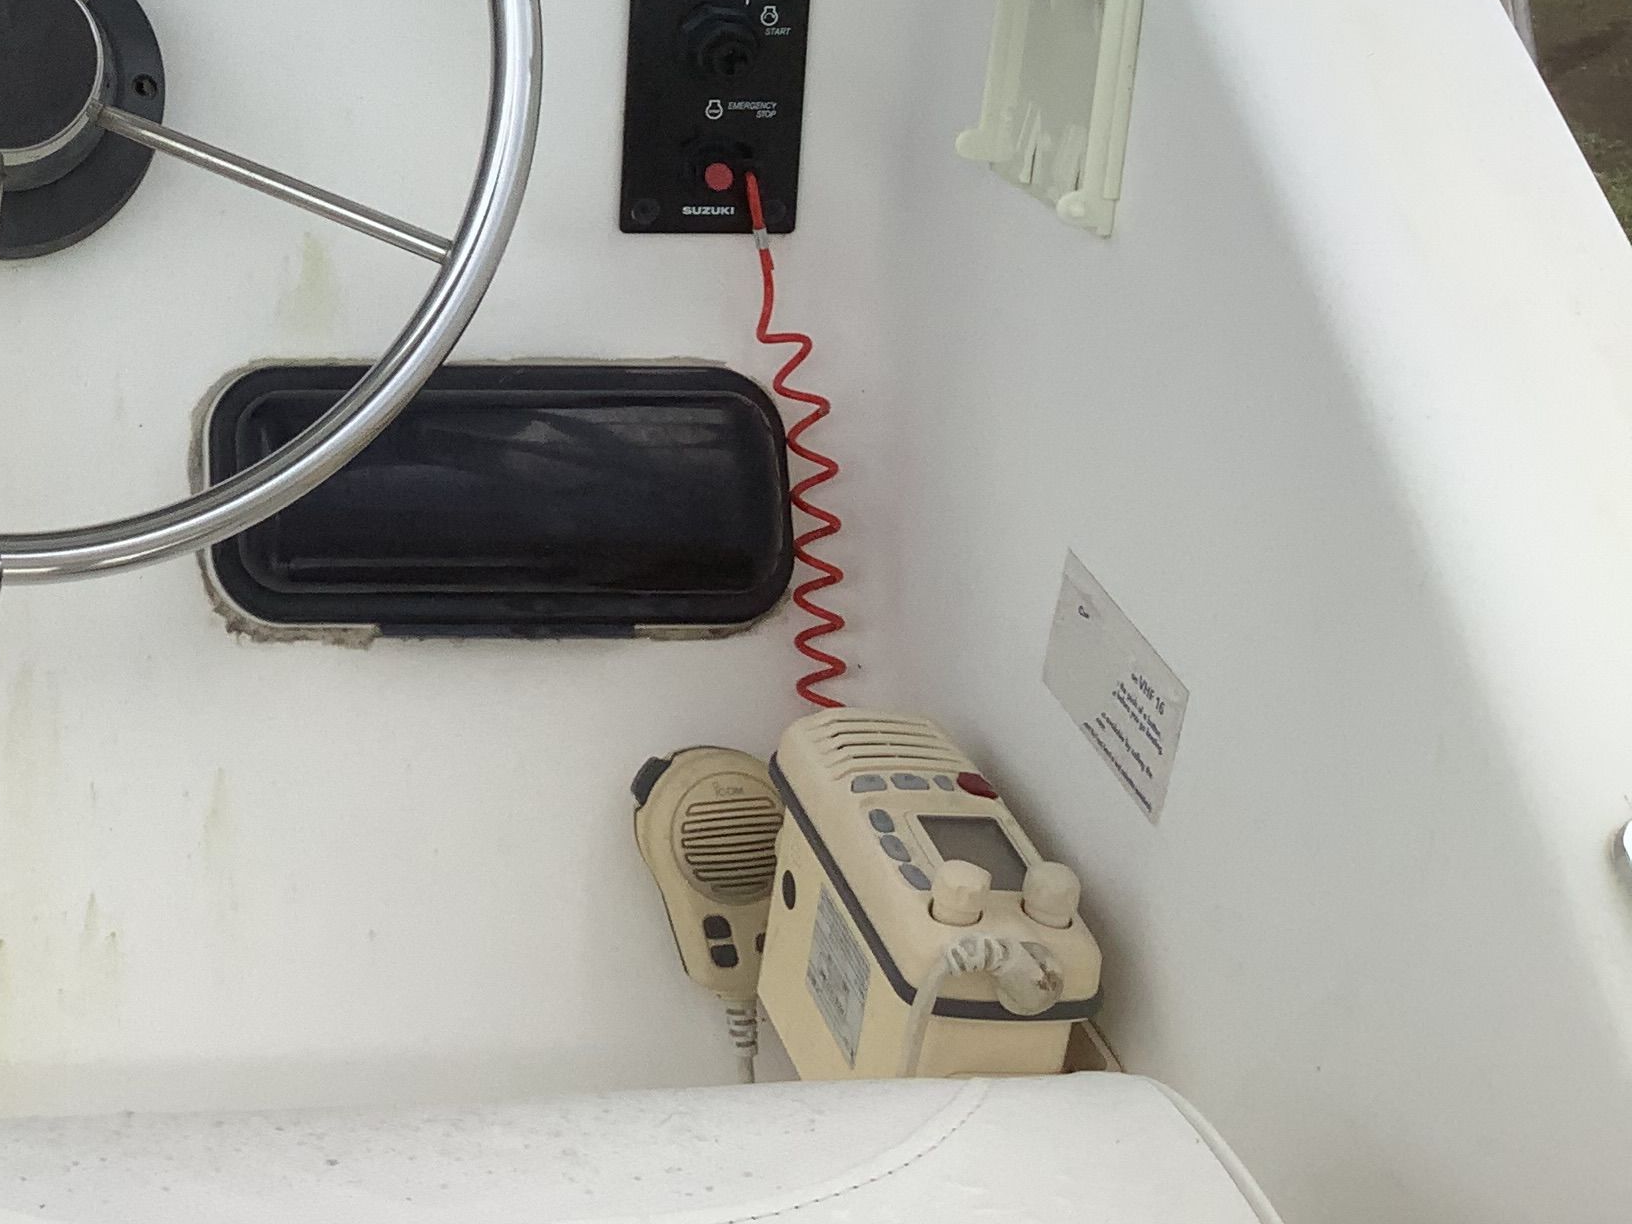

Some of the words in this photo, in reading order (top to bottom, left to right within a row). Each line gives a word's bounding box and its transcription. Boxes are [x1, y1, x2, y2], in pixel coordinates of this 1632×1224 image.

[765, 28, 791, 36] START
[728, 101, 777, 110] EMERGENCY
[756, 110, 777, 119] STOP
[682, 206, 735, 216] SUZUKI
[1139, 675, 1154, 700] VHF
[1155, 696, 1165, 715] 16
